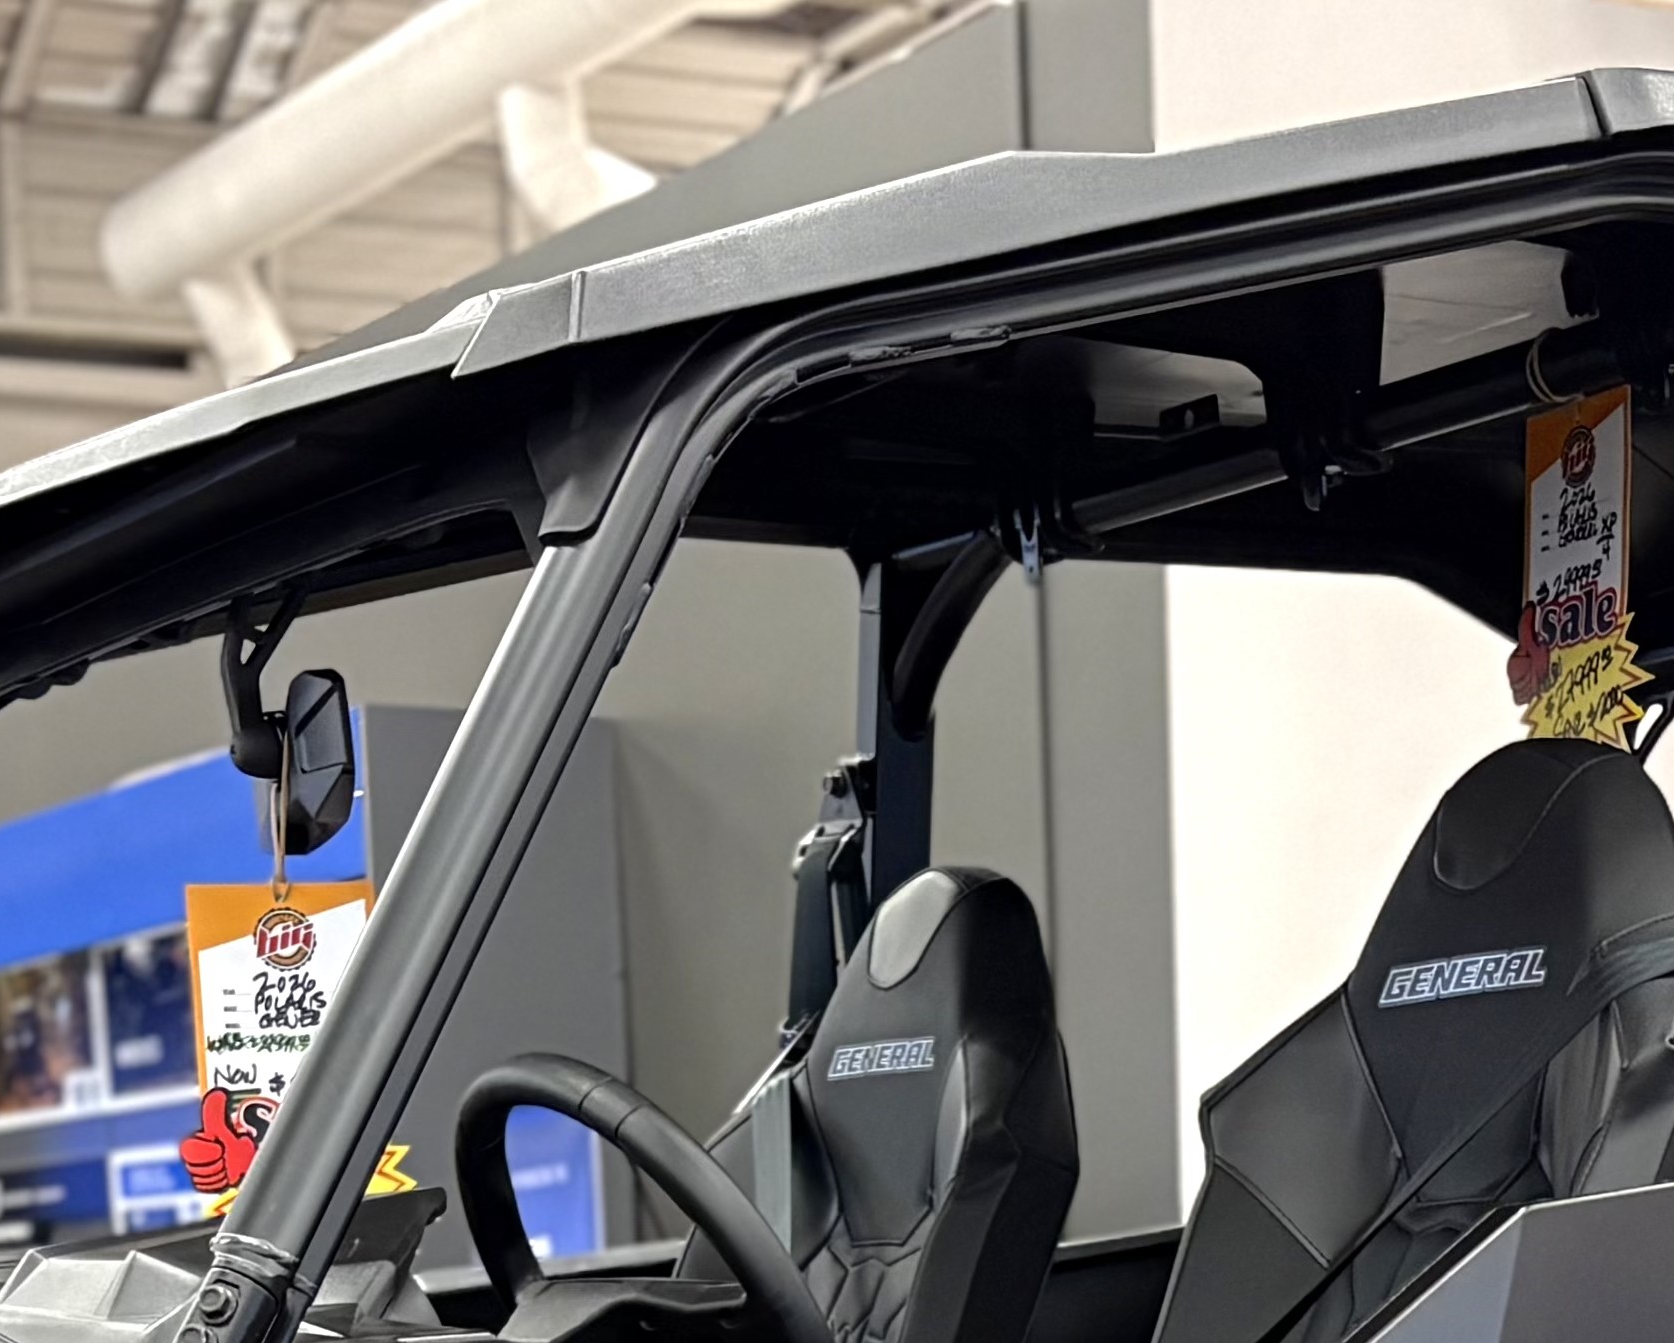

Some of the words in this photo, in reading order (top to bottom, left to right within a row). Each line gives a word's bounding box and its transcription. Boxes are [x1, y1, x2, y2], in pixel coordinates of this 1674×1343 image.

[1539, 586, 1617, 647] sale
[253, 971, 316, 994] 2026
[1379, 946, 1547, 1008] GENERAL
[828, 1036, 935, 1081] GENERAL
